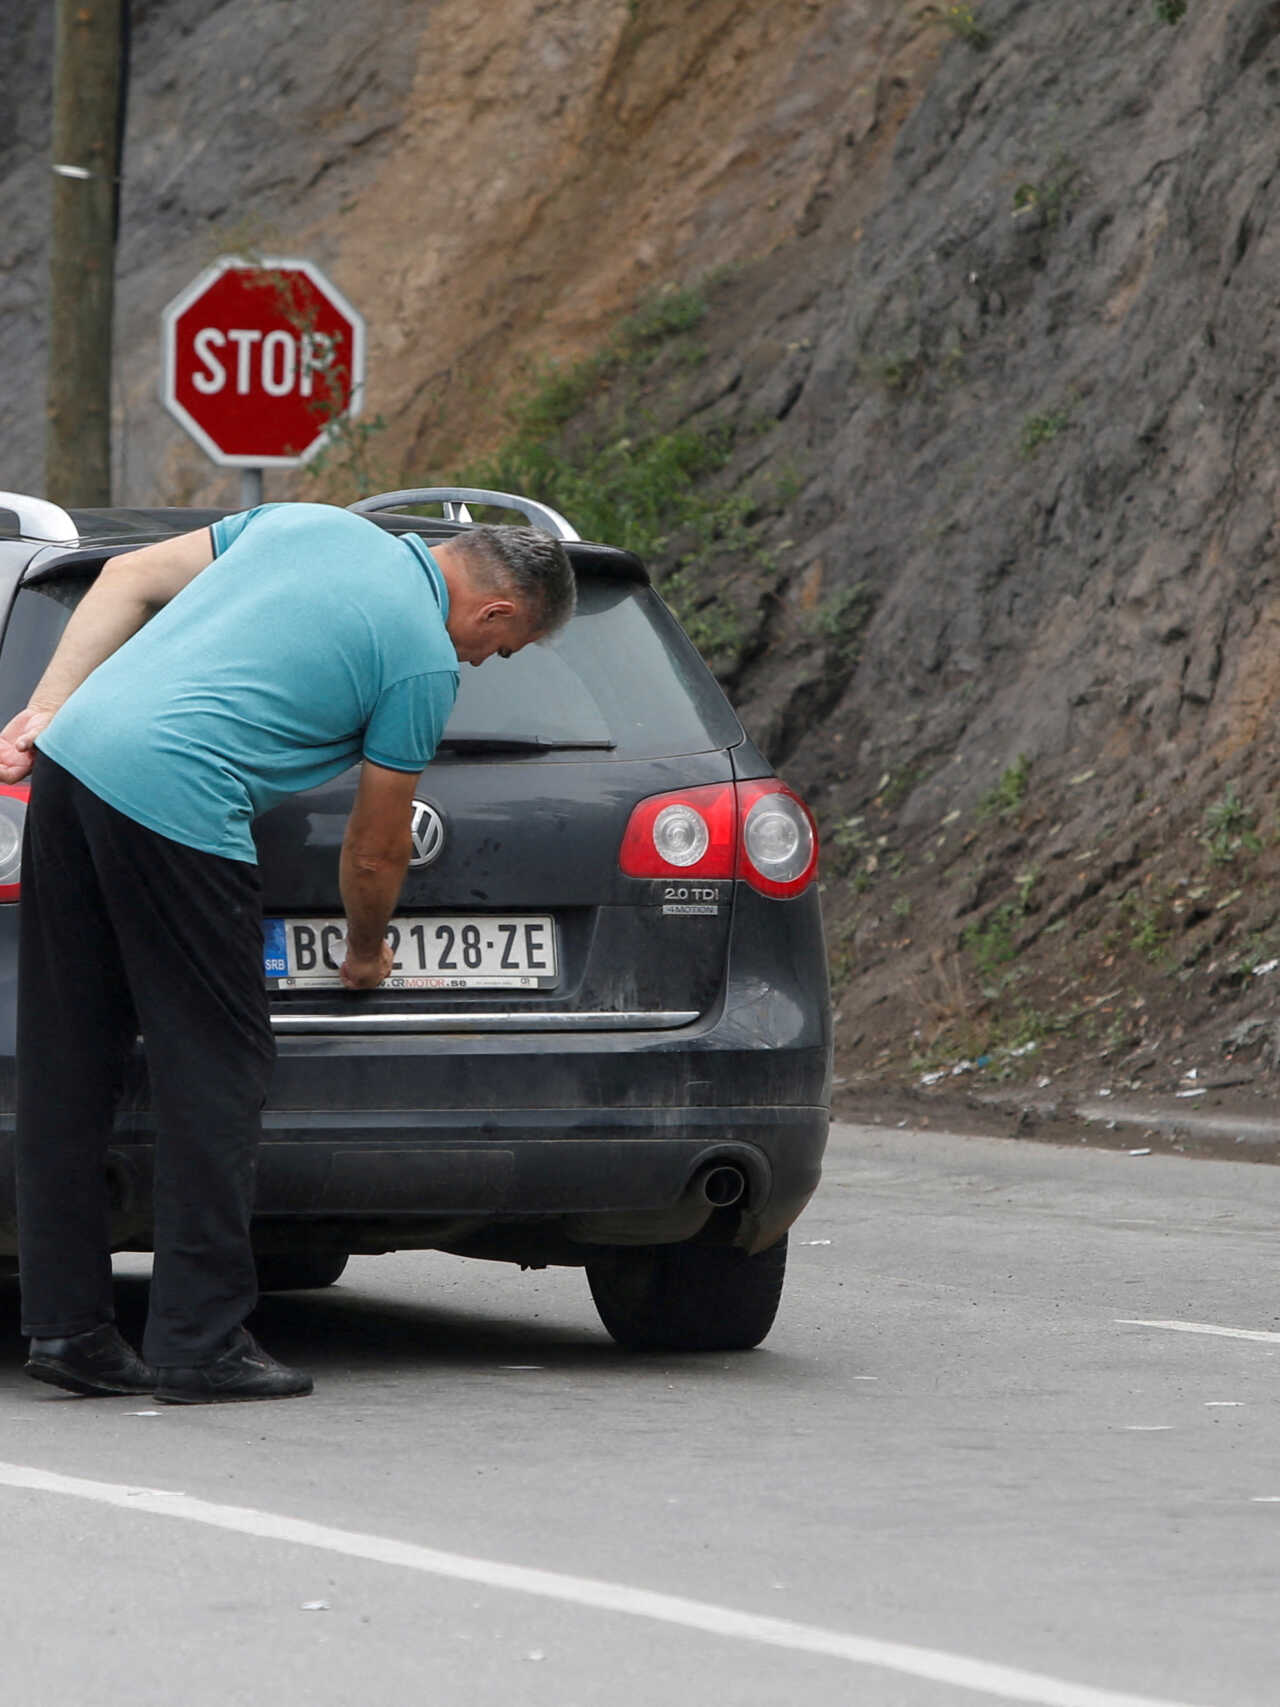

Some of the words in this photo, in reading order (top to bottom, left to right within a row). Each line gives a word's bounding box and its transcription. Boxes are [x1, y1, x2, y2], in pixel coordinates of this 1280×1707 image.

[191, 327, 336, 398] STOP
[691, 888, 720, 900] TDI
[265, 958, 285, 971] SRB
